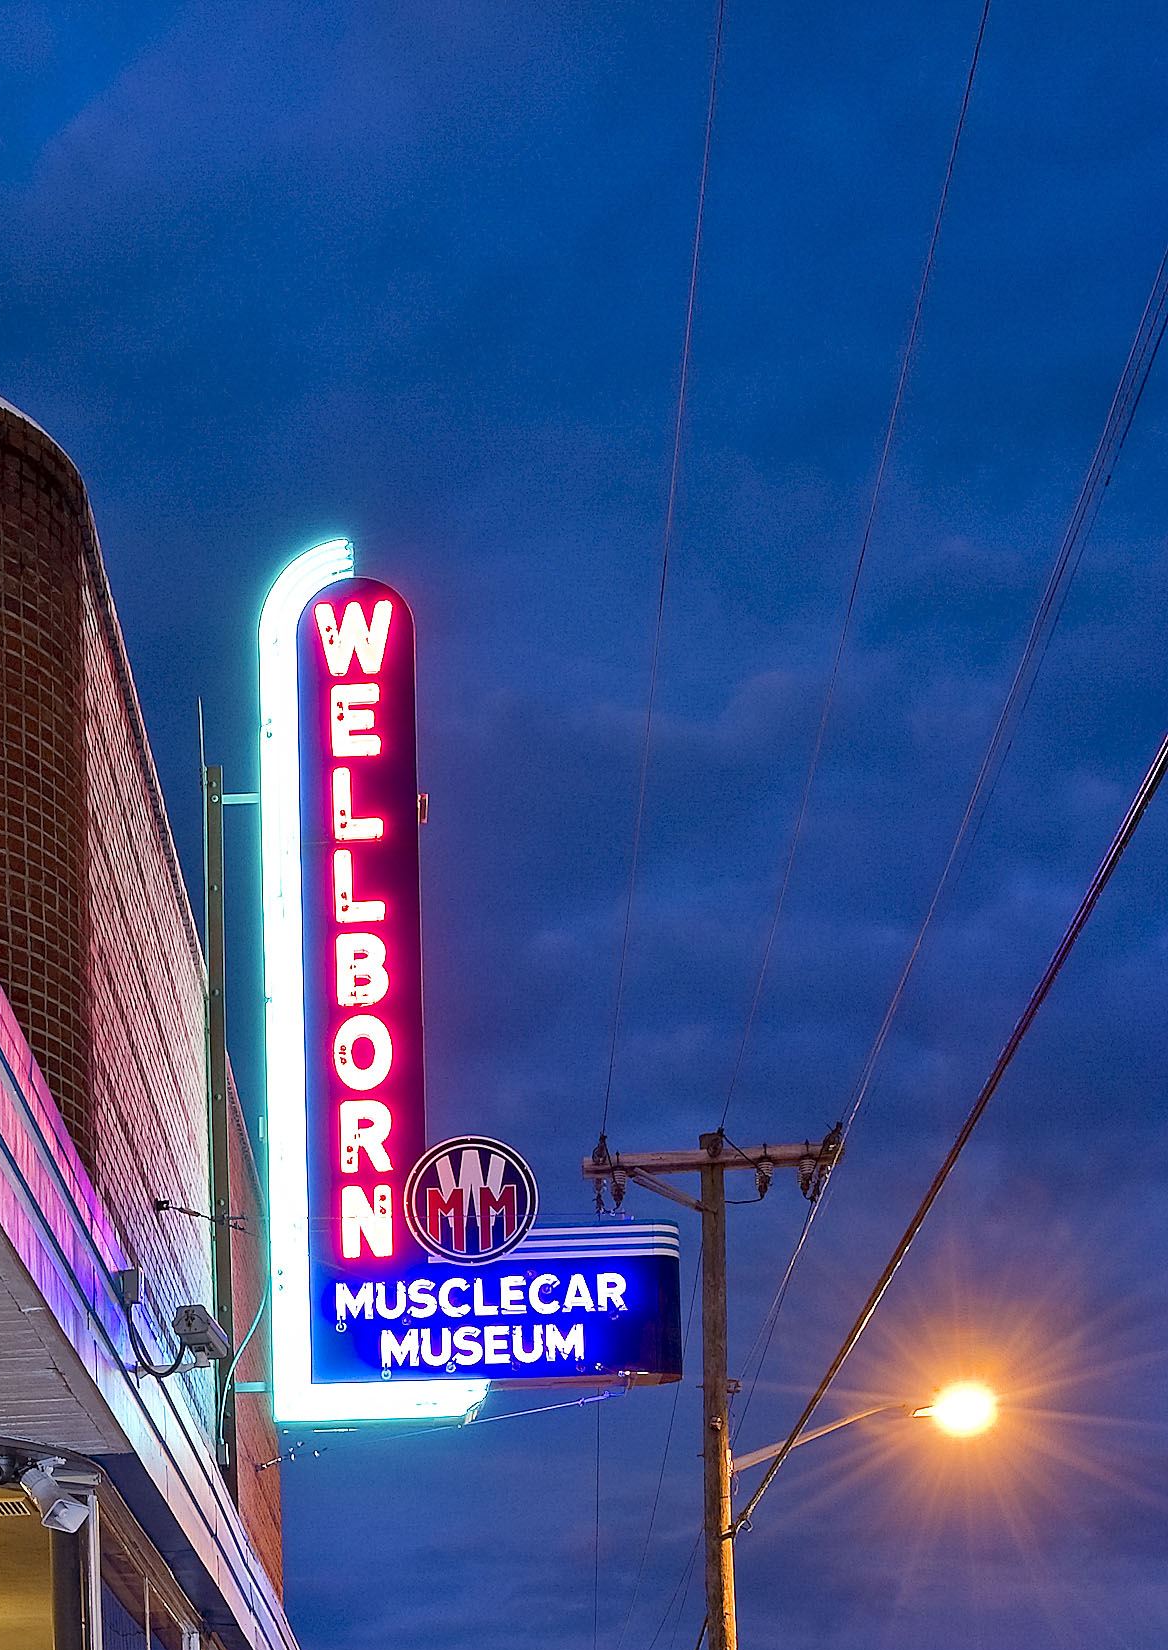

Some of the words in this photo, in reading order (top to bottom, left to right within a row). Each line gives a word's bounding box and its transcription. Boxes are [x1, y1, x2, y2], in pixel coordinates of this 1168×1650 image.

[314, 600, 394, 1259] WELLBORN
[335, 1272, 628, 1320] MUSCLECAR
[381, 1323, 585, 1368] MUSEUM
